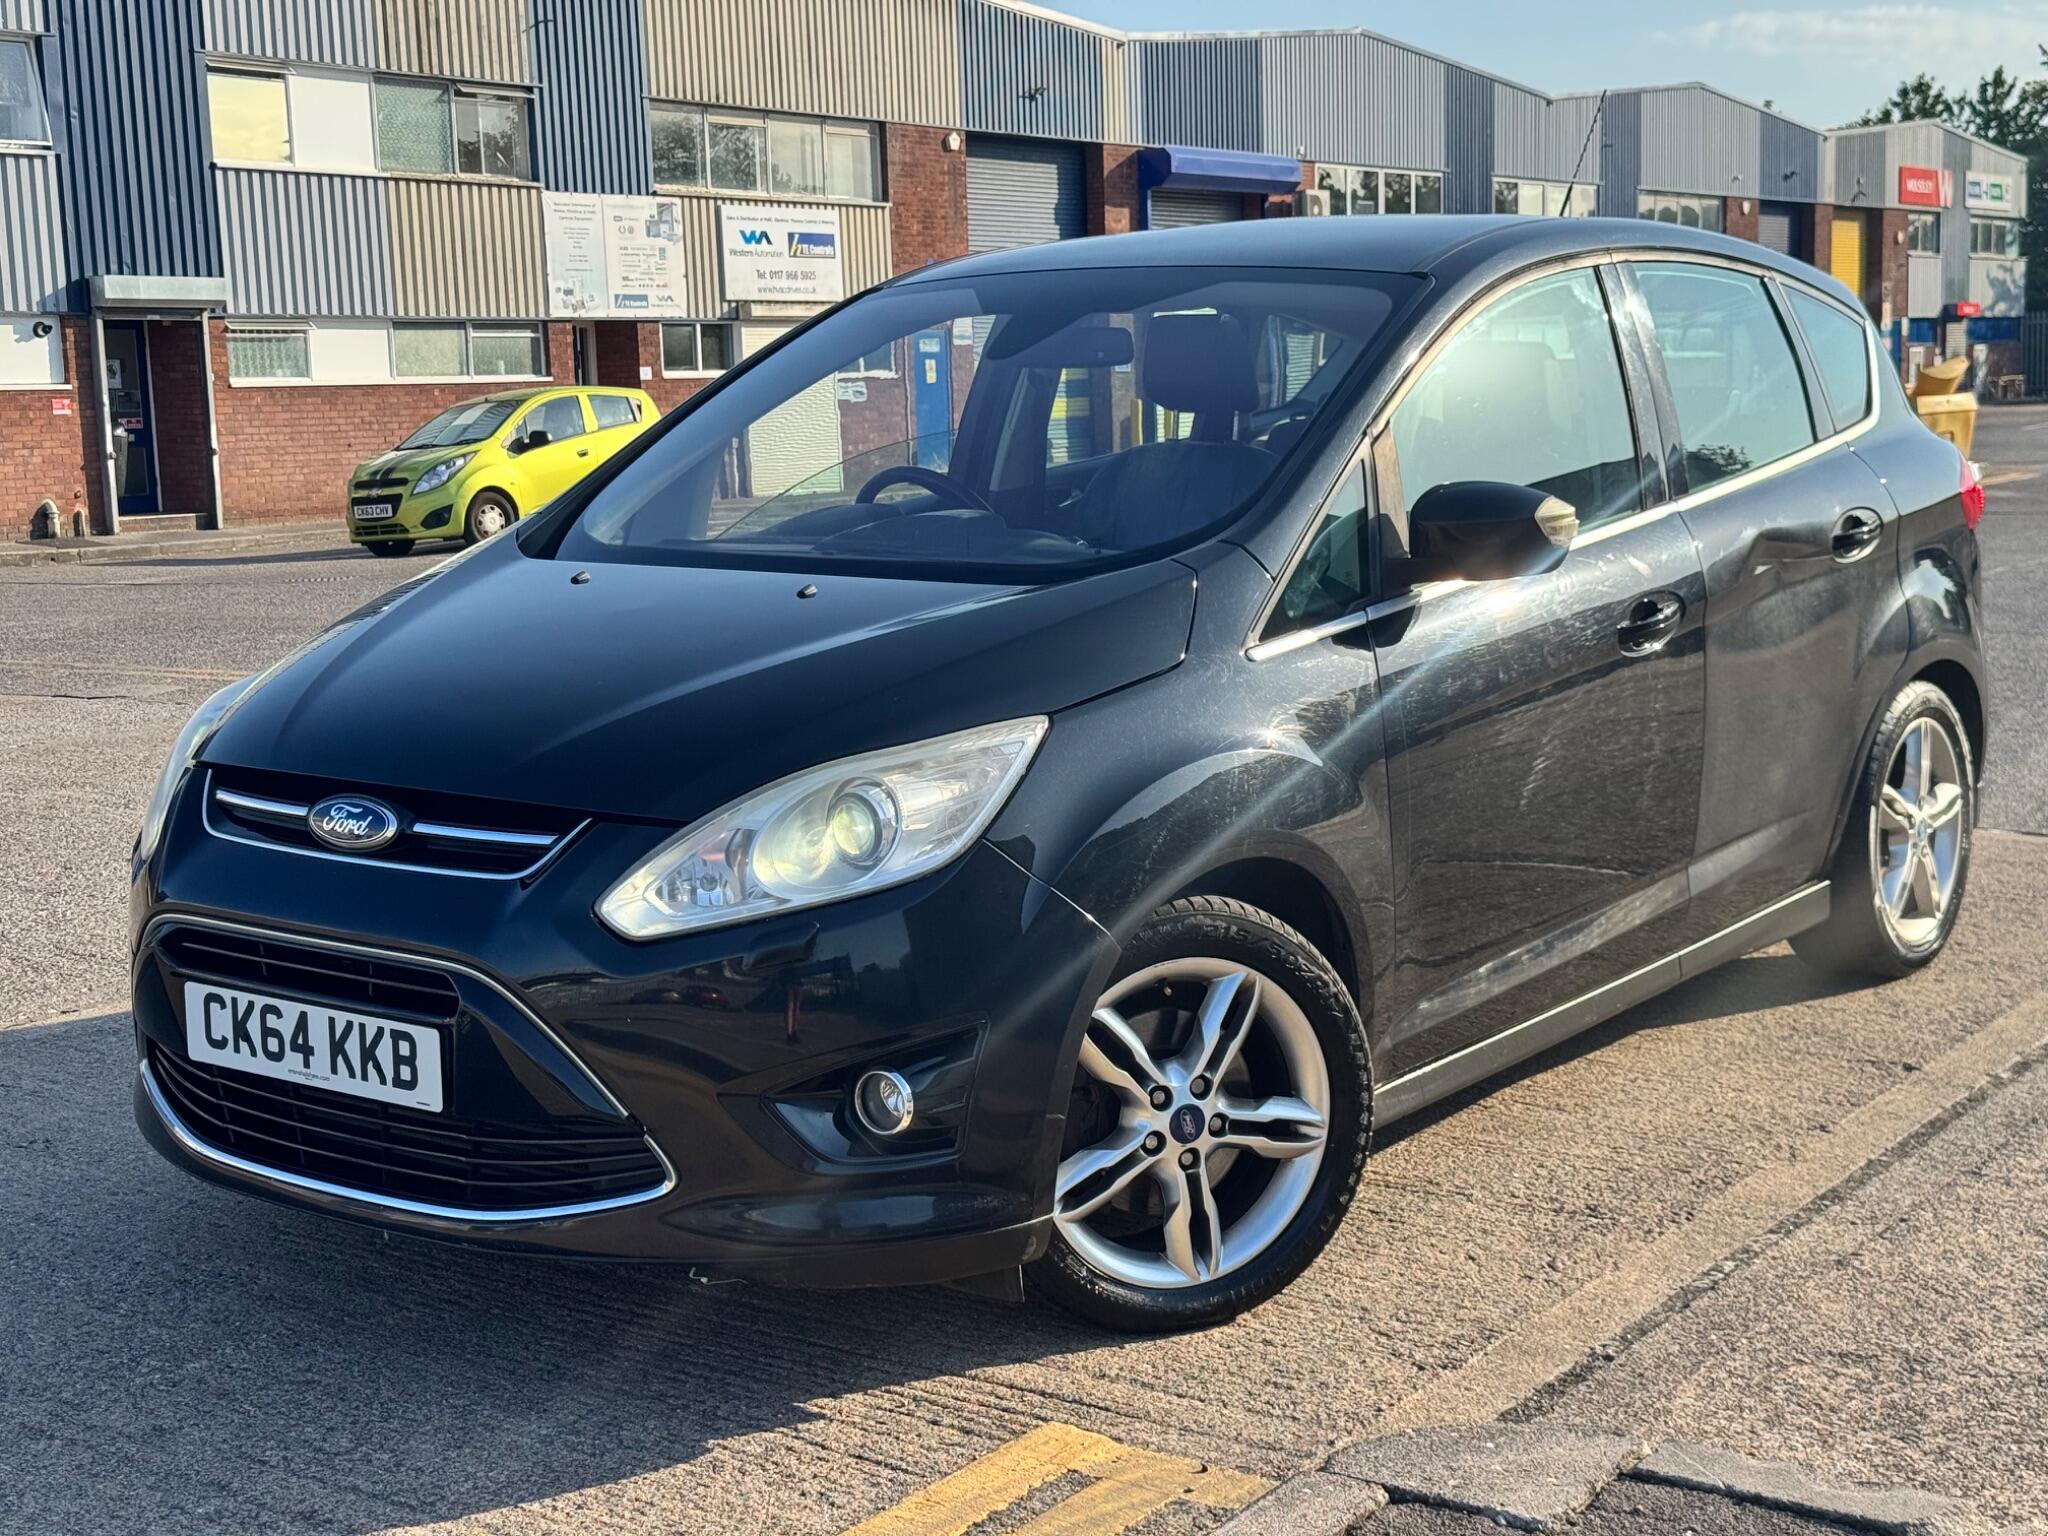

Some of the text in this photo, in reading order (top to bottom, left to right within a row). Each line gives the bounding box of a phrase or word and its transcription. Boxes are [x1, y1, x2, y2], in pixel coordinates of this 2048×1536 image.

[728, 248, 784, 258] Western Automation
[756, 269, 816, 281] Tel: 0117 966 5925
[375, 505, 389, 516] CHV
[322, 803, 373, 835] Ford
[203, 991, 419, 1092] CK64 KKB
